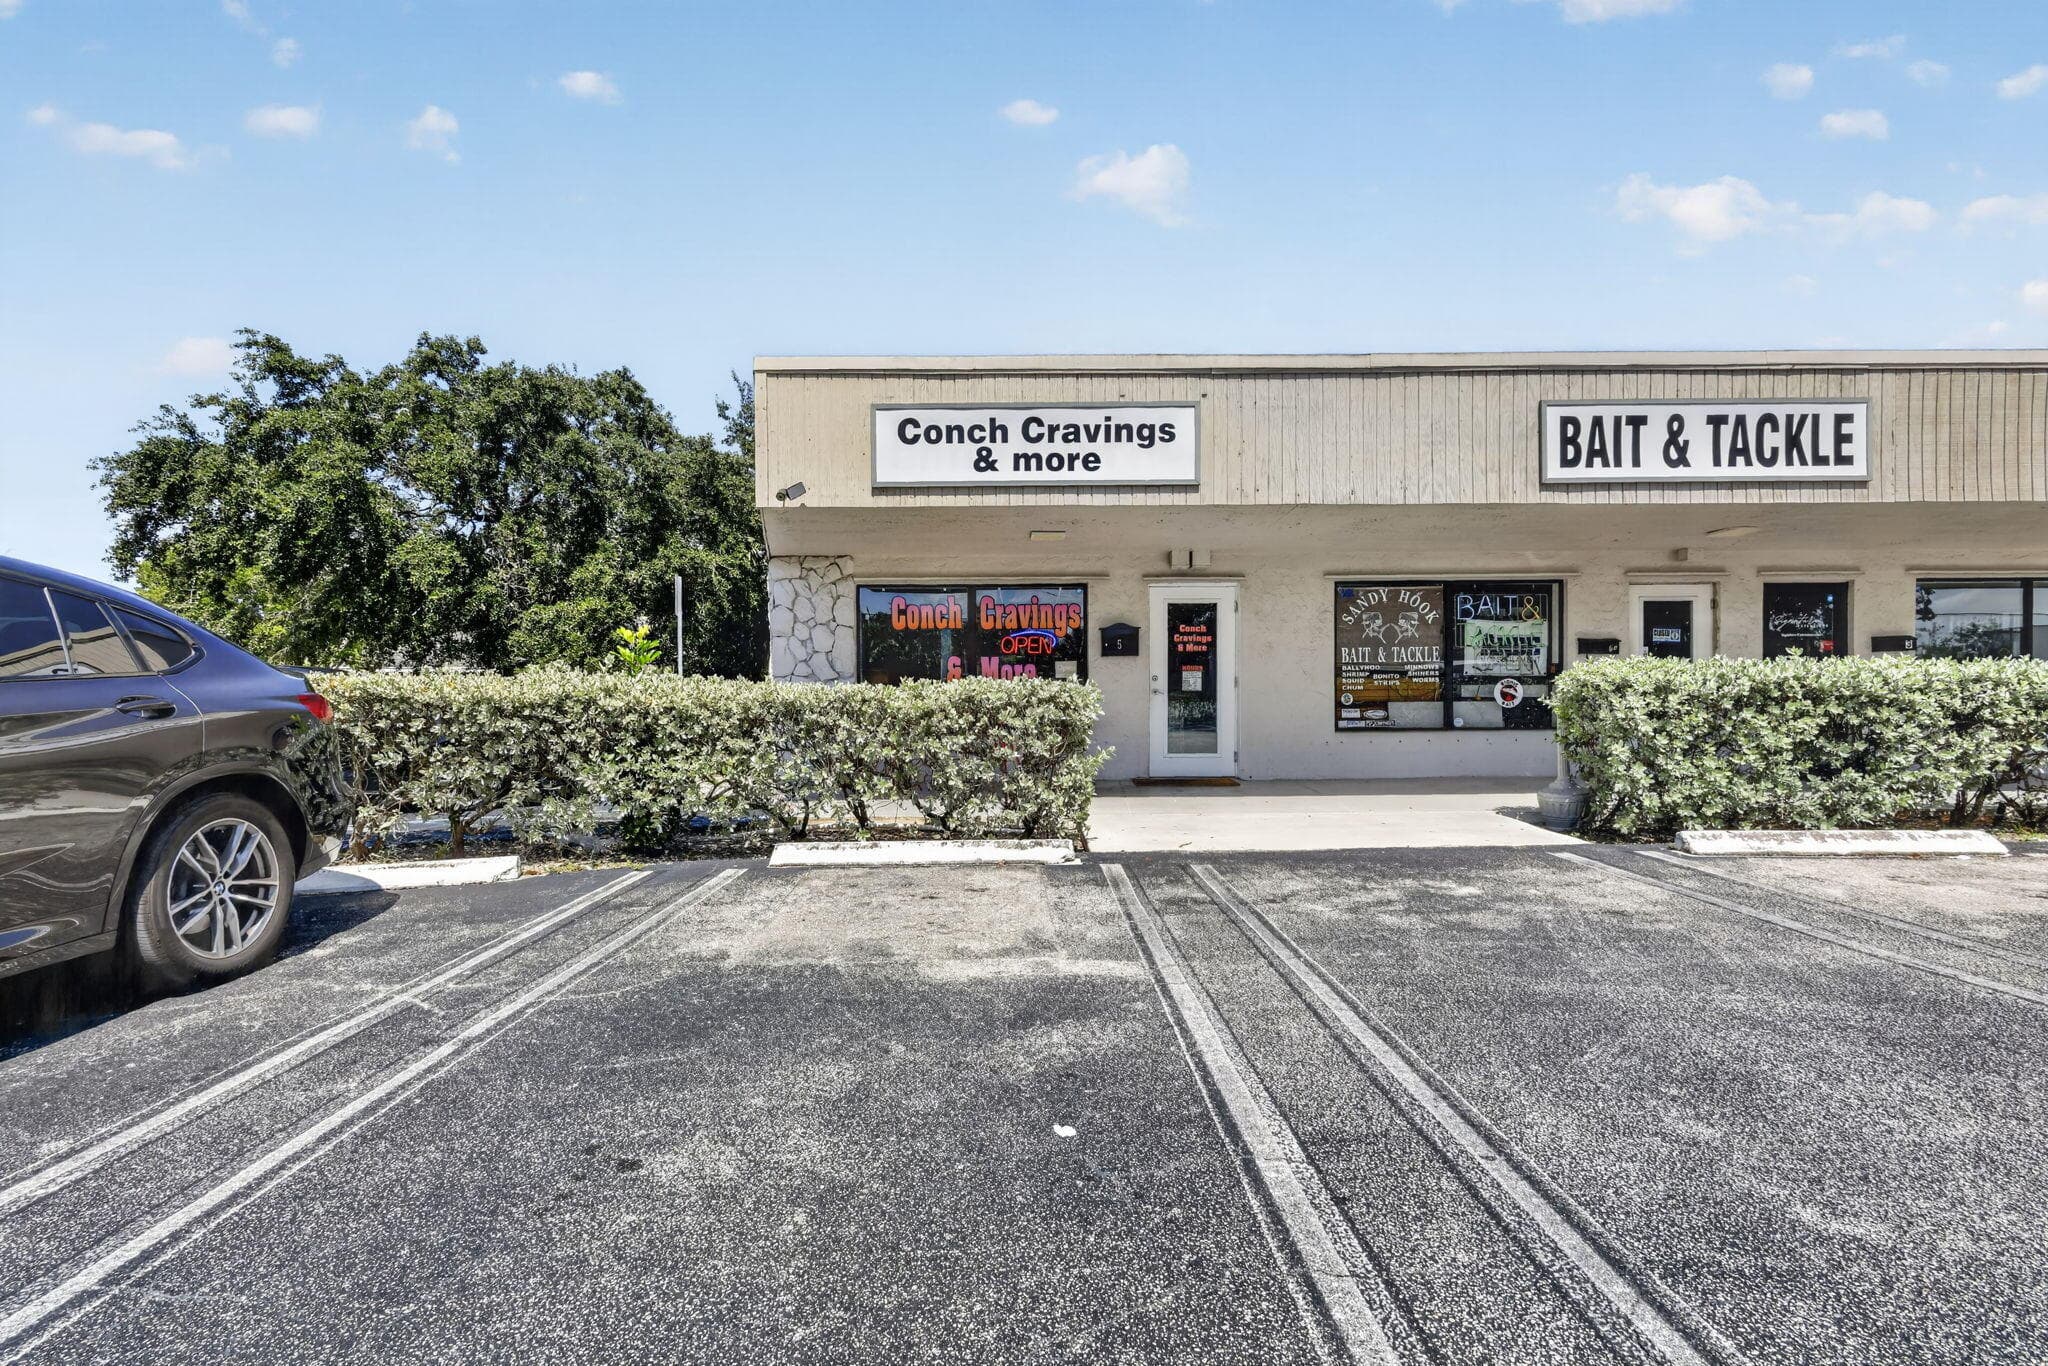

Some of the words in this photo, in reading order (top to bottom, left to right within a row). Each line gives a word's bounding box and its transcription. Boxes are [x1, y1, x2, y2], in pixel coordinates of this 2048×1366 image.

[898, 417, 1008, 446] Conch
[1021, 415, 1176, 448] Cravings
[1559, 415, 1648, 469] BAIT
[1662, 413, 1692, 469] &
[1706, 412, 1855, 468] TACKLE
[973, 446, 999, 472] &
[1013, 452, 1101, 472] more
[891, 595, 963, 631] Conch
[979, 595, 1082, 638] Cravings
[1342, 588, 1388, 625] SANDY
[1398, 589, 1439, 625] HOOK
[1457, 595, 1517, 620] BAIT
[1521, 595, 1540, 621] &
[1173, 634, 1213, 643] Cravings
[1179, 624, 1207, 633] Conch
[1001, 636, 1052, 655] OPEN
[1117, 639, 1122, 650] 5
[1186, 643, 1208, 652] More
[1341, 647, 1371, 662] BAIT
[1378, 646, 1386, 662] &
[1391, 645, 1440, 662] TACKLE
[946, 655, 962, 682] &
[980, 656, 1038, 681] More
